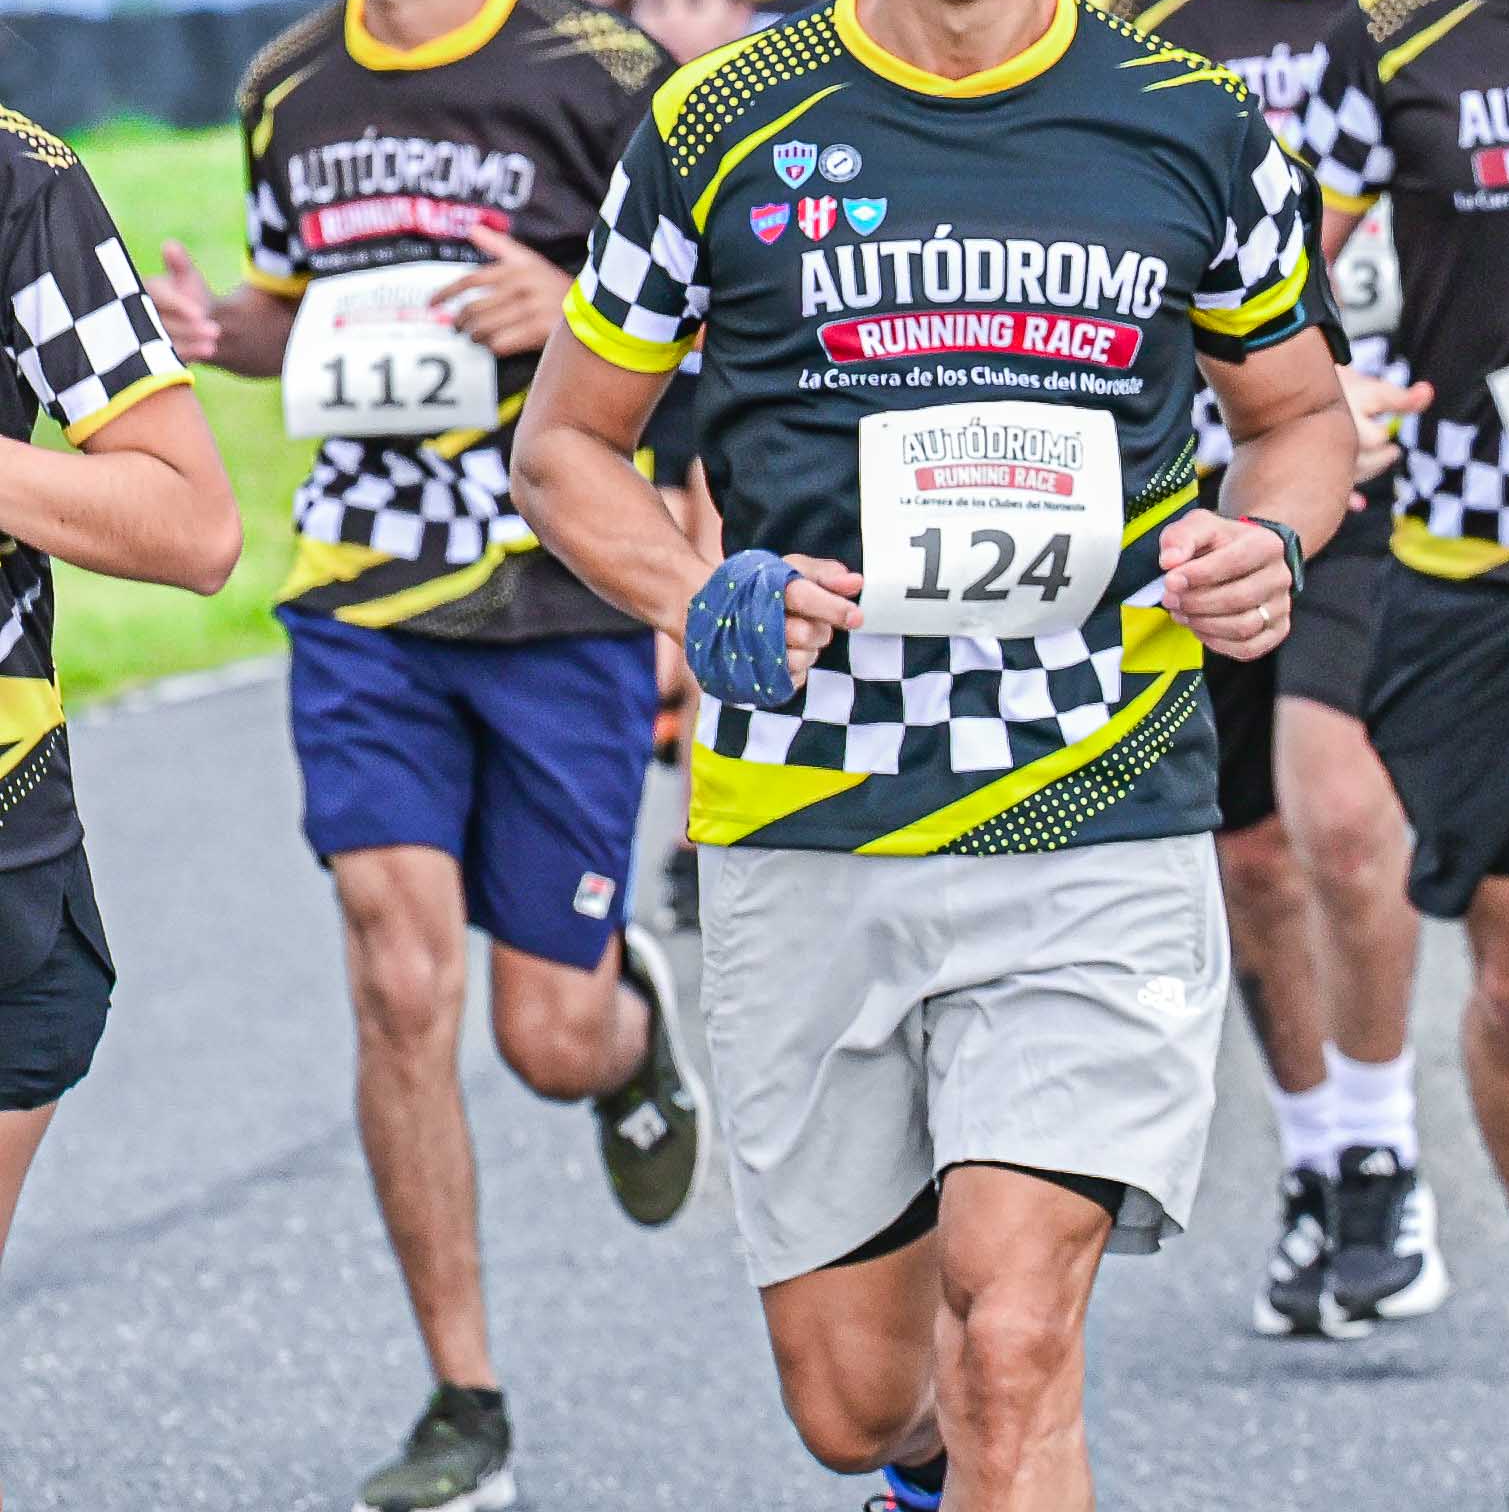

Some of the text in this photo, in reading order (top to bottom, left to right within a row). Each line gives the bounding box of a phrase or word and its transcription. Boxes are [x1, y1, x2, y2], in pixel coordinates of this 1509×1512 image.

[802, 223, 1169, 319] AUTÓDROMO
[857, 314, 1116, 363] RUNNING RACE
[320, 353, 458, 410] 112
[798, 368, 821, 390] La
[824, 368, 901, 389] Carrera
[905, 366, 934, 387] de
[937, 365, 968, 387] los
[970, 366, 1041, 389] Clubes
[1043, 370, 1076, 391] del
[903, 417, 1084, 471] AUTÓDROMO
[933, 466, 1057, 494] RUNNING RACE
[904, 527, 1073, 603] 124
